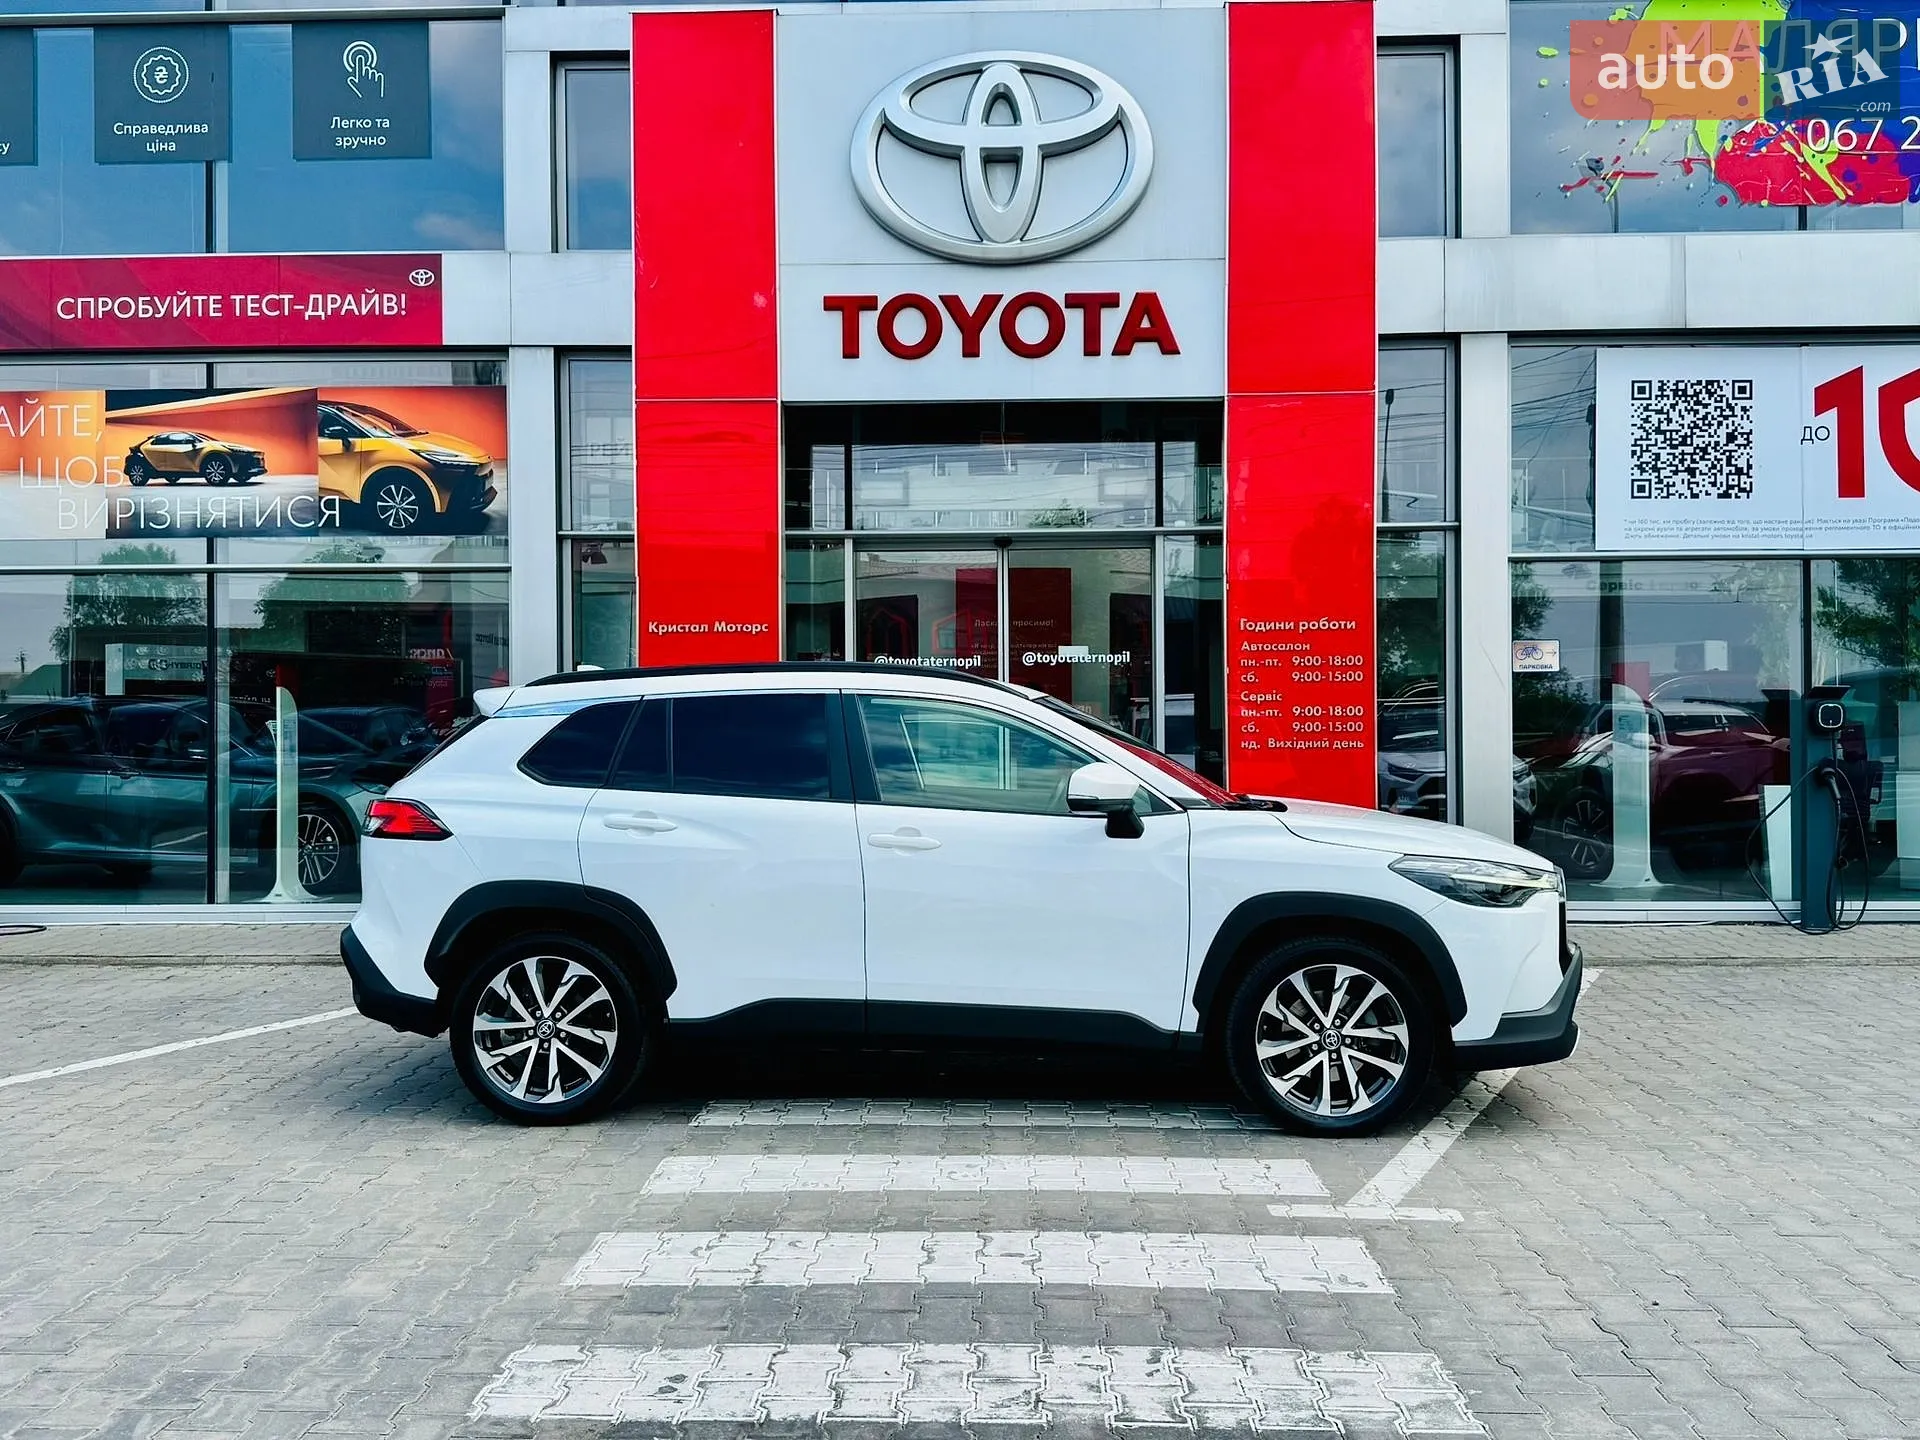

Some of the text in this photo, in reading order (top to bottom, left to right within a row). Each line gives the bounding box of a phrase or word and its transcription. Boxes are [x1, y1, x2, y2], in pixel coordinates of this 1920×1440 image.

[1659, 18, 1920, 77] МАЛЯР
[113, 121, 209, 137] Справедлива
[331, 117, 390, 131] Легко та
[335, 133, 387, 149] зручно
[1807, 118, 1884, 153] 067
[146, 138, 176, 154] ціна
[56, 287, 407, 321] СПРОБУЙТЕ ТЕСТ-ДРАЙВ!
[823, 291, 1180, 360] TOYOTA
[20, 456, 124, 495] ЩОБ
[57, 495, 341, 532] ВИРІЗНЯТИСЯ
[648, 621, 769, 636] Кристал Моторс
[1240, 617, 1356, 633] Години роботи
[1241, 641, 1310, 651] Автосалон
[1022, 651, 1130, 668] @toyotaternopil
[1292, 655, 1363, 667] 9:00-18:00
[1292, 671, 1363, 683] 9:00-15:00
[1240, 690, 1282, 704] Сервіс
[1292, 705, 1364, 717] 9:00-18:00
[1292, 721, 1364, 733] 9:00-15:00
[1241, 738, 1364, 750] нд. Вихідний день
